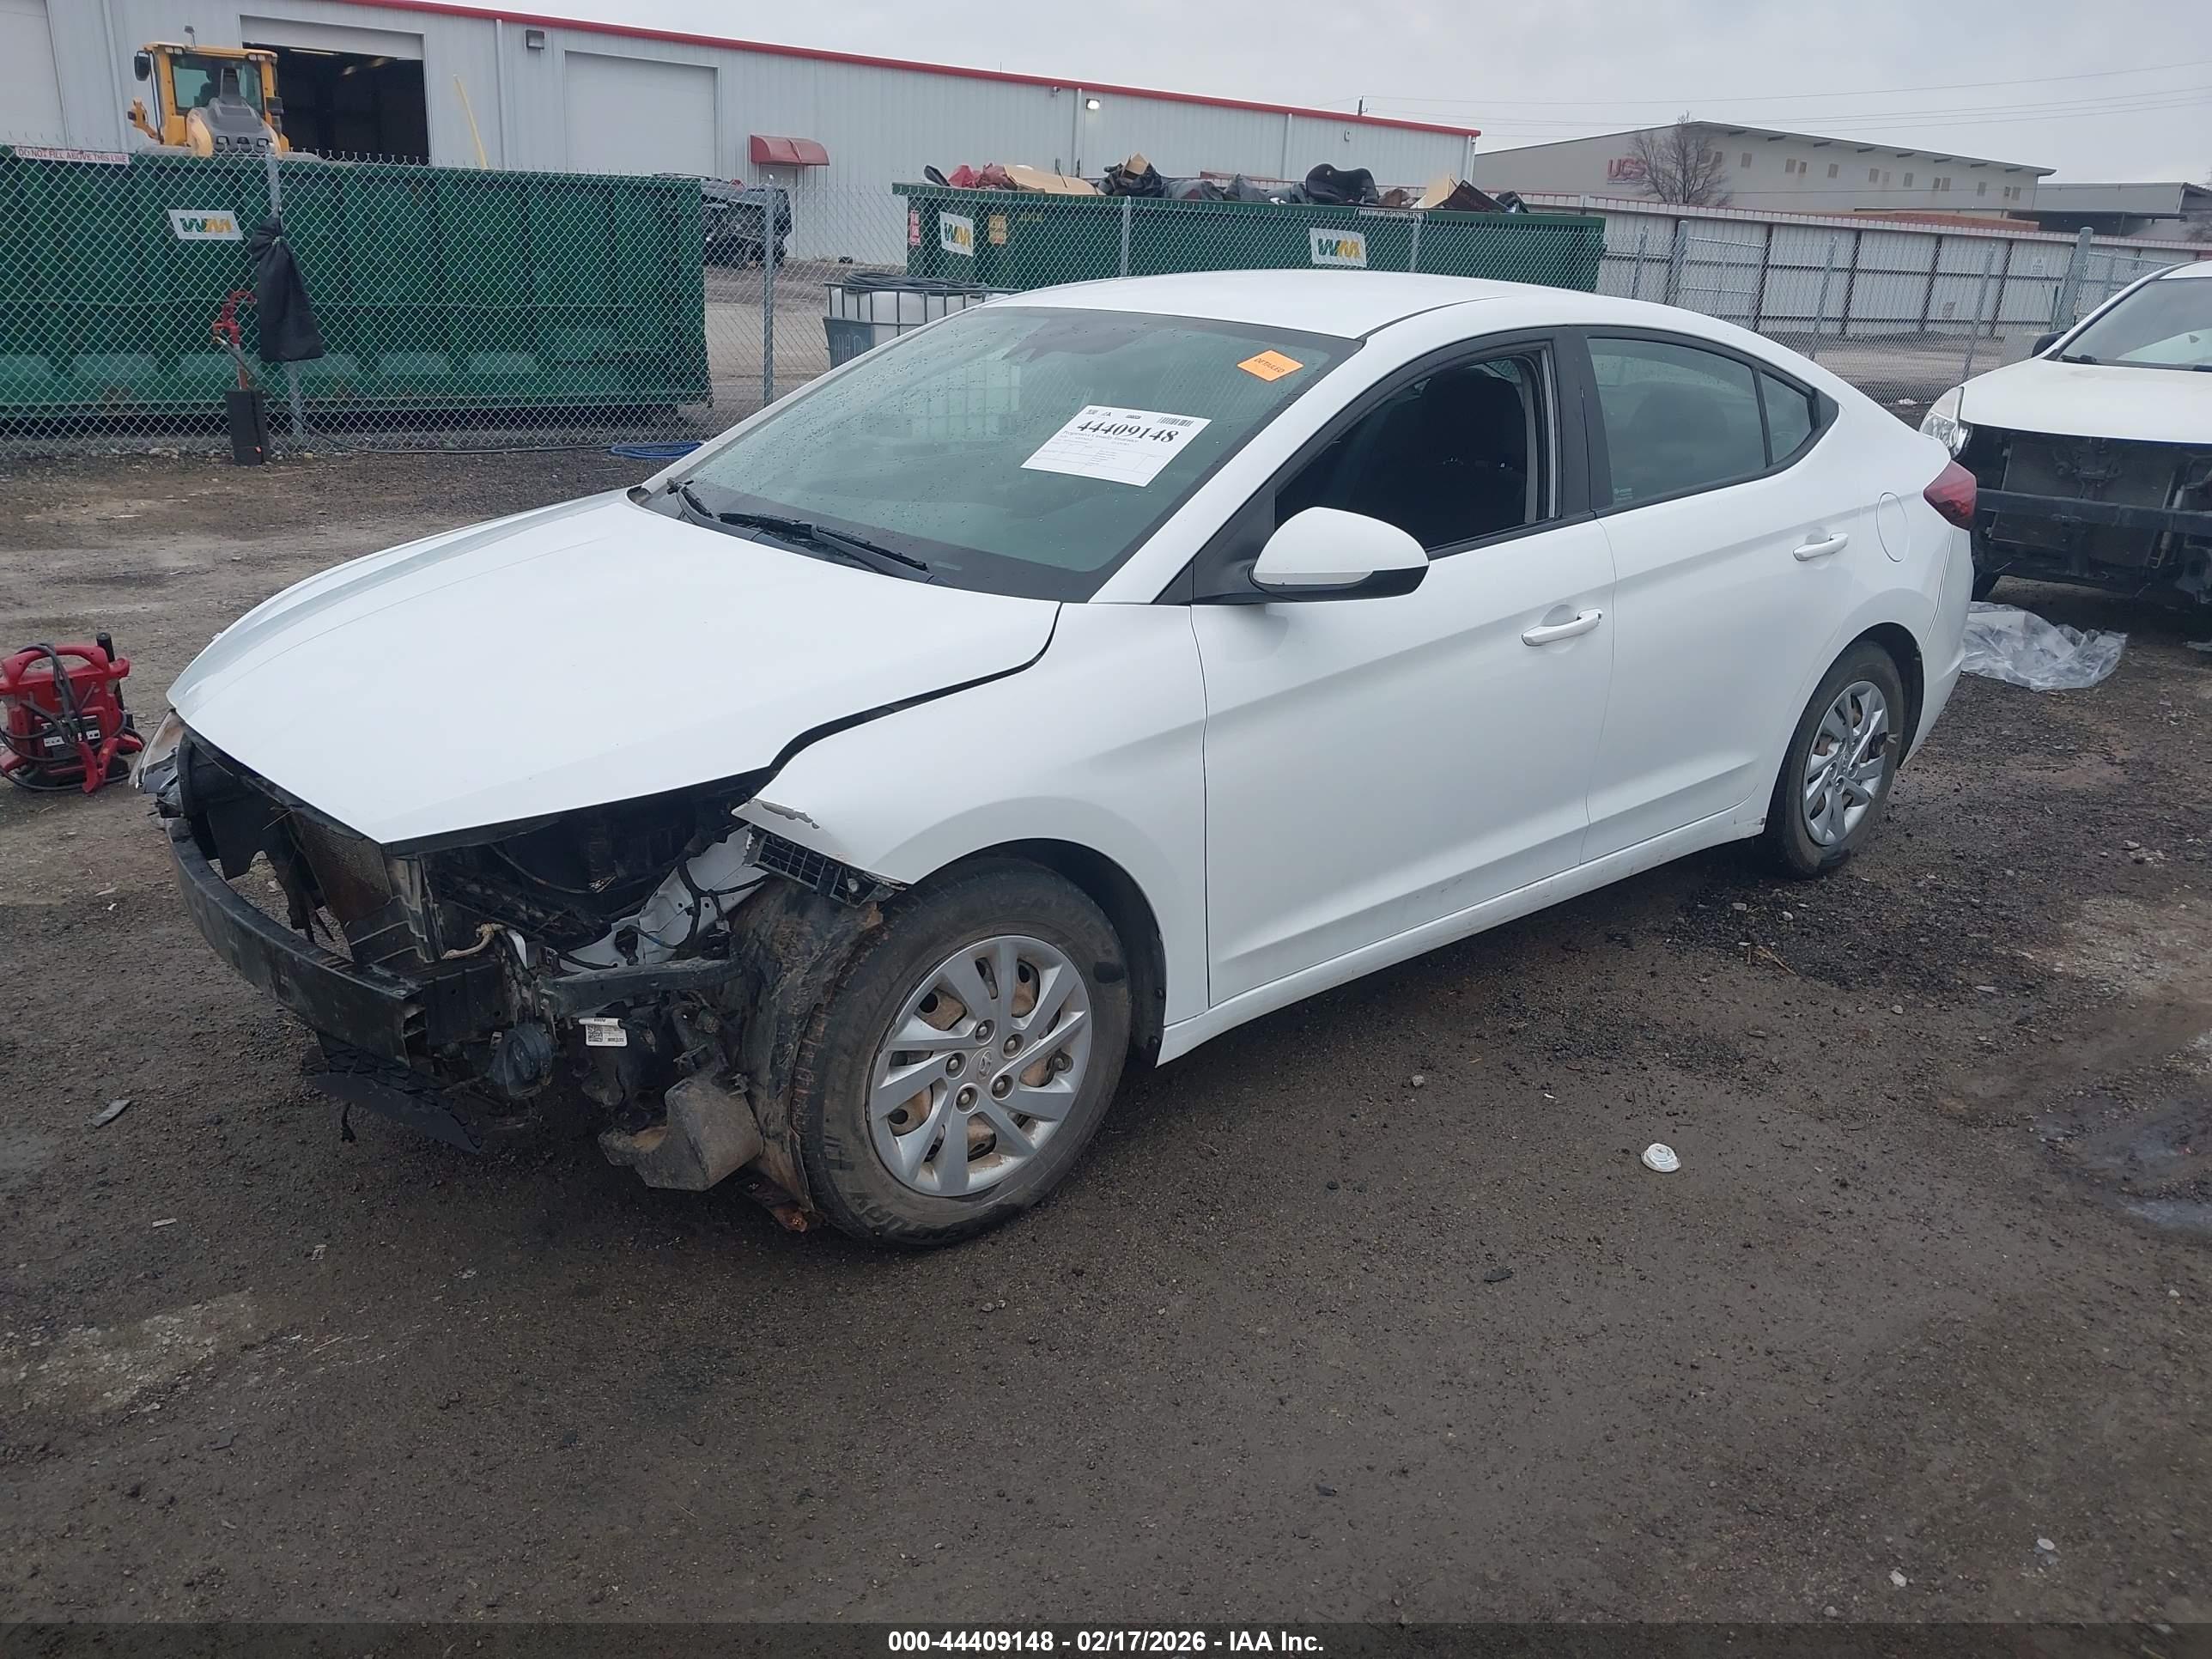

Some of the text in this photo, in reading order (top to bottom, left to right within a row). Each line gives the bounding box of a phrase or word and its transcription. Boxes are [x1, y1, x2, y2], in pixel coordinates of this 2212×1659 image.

[18, 148, 30, 156] DO
[49, 150, 64, 159] FILL
[66, 151, 92, 161] ABOVE
[94, 153, 110, 161] THIS
[111, 154, 127, 162] LINE
[179, 217, 233, 233] WM
[944, 222, 971, 247] WM
[1316, 238, 1361, 258] WM
[1254, 357, 1285, 373] DETAILED
[1077, 420, 1179, 443] 44409148
